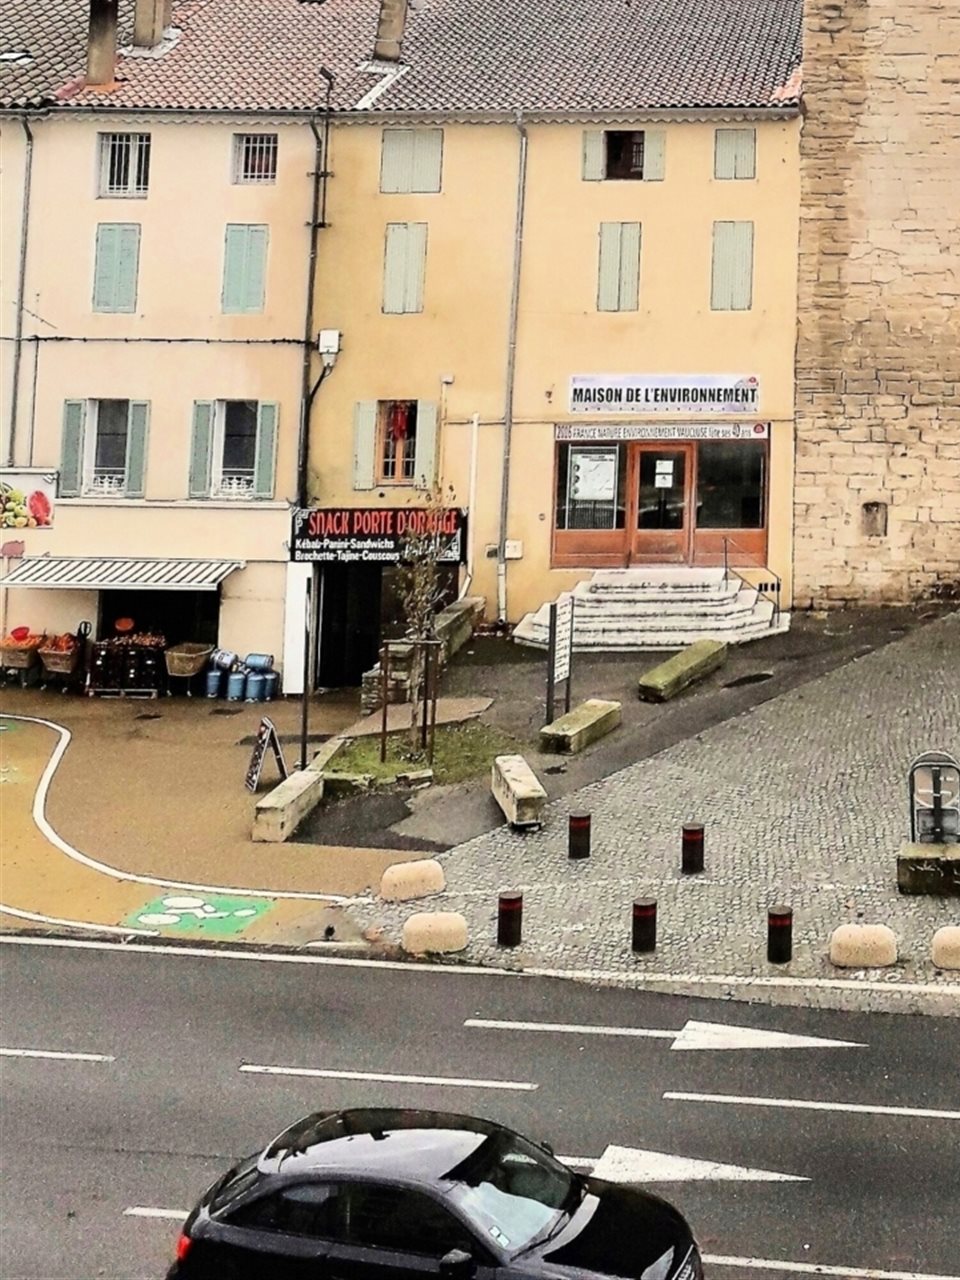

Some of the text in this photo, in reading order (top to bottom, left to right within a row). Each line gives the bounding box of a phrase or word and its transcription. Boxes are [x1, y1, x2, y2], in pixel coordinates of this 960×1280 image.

[572, 387, 757, 403] MAISON DE L'ENVIRONNEMENT
[308, 511, 350, 537] SNACK
[354, 511, 394, 535] PORTE
